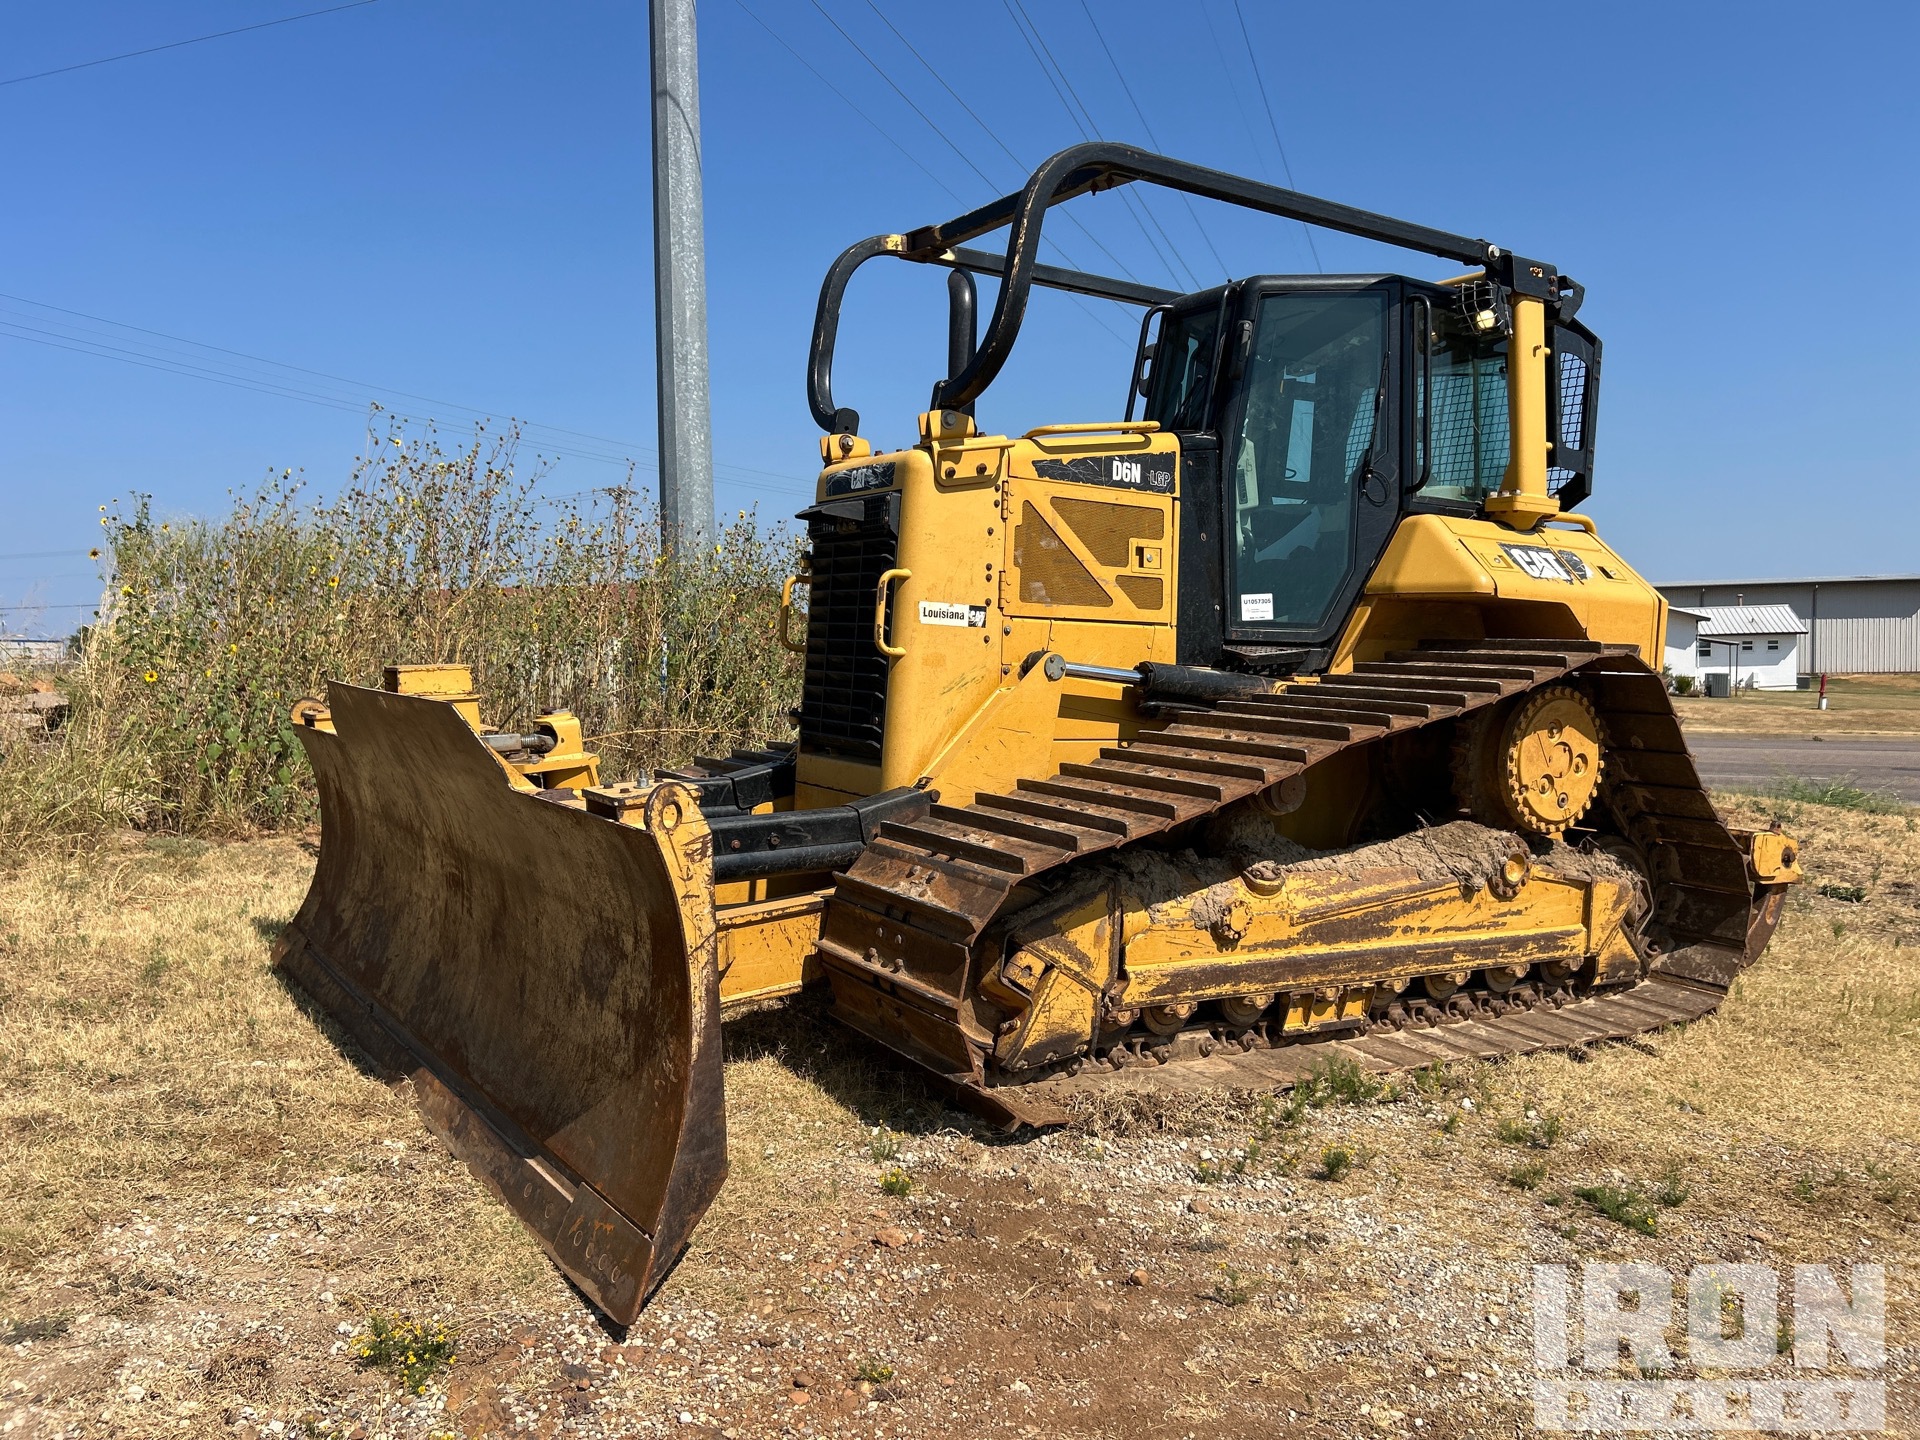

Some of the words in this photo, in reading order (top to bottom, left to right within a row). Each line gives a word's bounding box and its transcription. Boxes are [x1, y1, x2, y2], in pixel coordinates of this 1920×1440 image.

[851, 468, 867, 489] CAT
[1112, 460, 1141, 483] D6N
[1150, 470, 1170, 487] LGP
[1510, 548, 1571, 580] CAT
[923, 607, 965, 620] Louisiana
[968, 610, 986, 627] CAT
